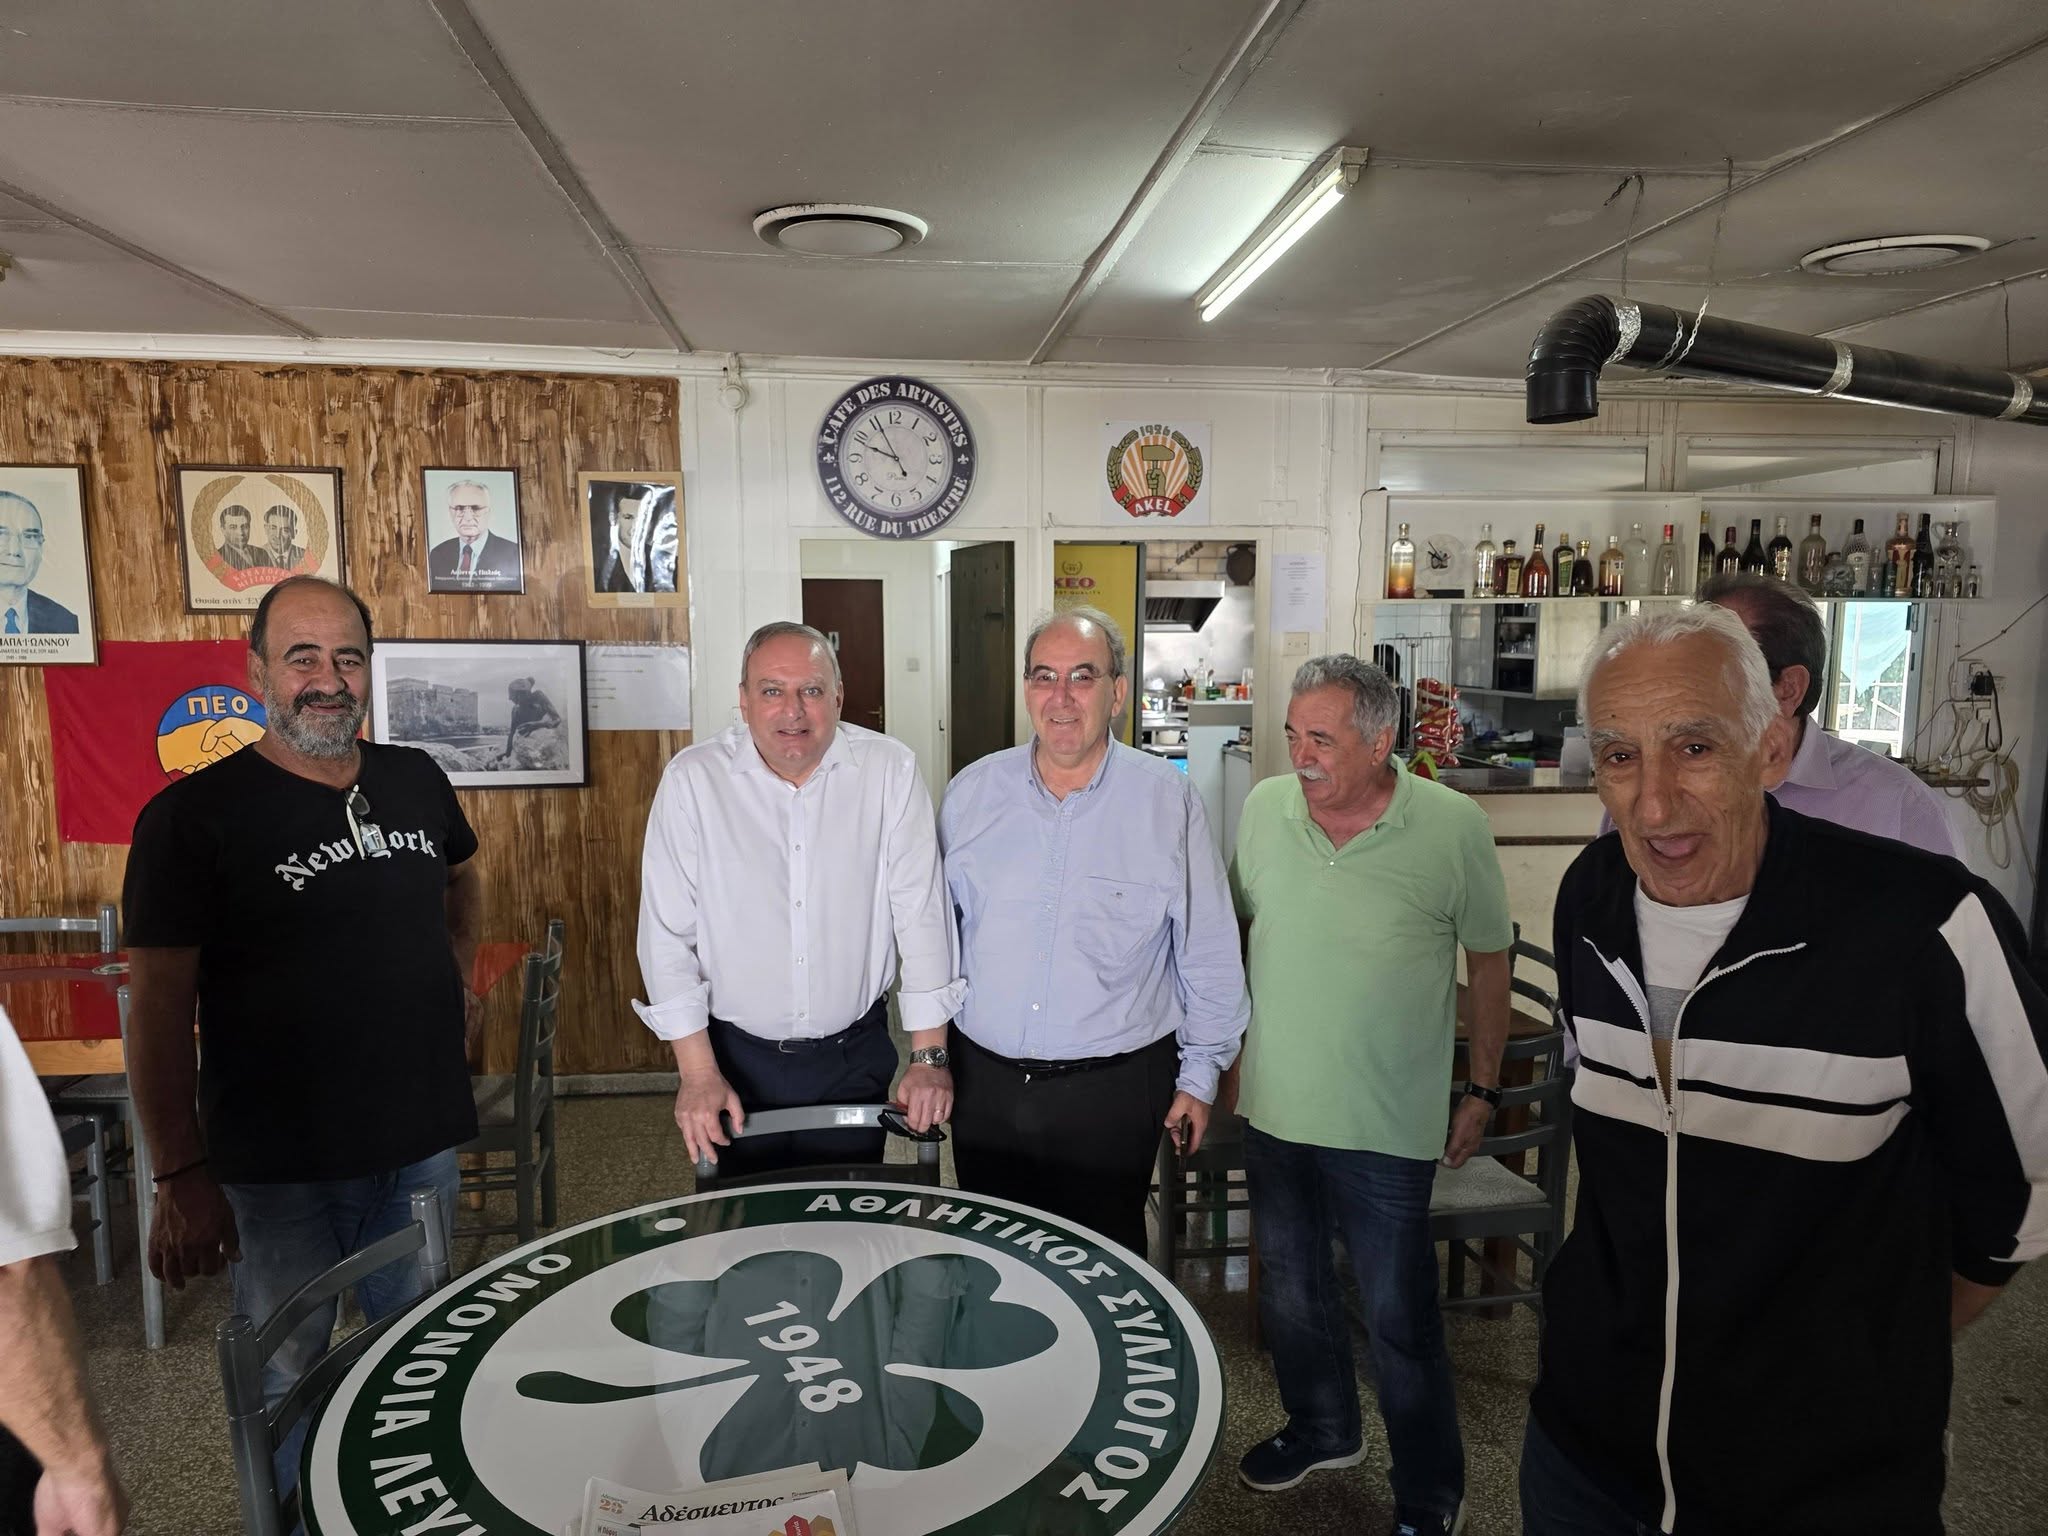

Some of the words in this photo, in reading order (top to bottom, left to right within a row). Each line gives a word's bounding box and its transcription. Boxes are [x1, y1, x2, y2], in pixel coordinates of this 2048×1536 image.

[822, 398, 857, 445] CAFE
[856, 382, 891, 405] DES
[896, 383, 968, 447] ARTISTES
[889, 410, 902, 424] 12
[911, 417, 920, 430] 1
[1140, 424, 1171, 437] 1926
[853, 430, 869, 445] 10
[923, 431, 937, 447] 2
[848, 453, 863, 464] 9
[929, 454, 944, 466] 3
[855, 472, 869, 487] 8
[871, 486, 884, 500] 7
[891, 493, 901, 507] 6
[909, 487, 923, 501] 5
[1135, 499, 1172, 514] AKEL
[880, 520, 903, 536] DU
[1055, 577, 1096, 589] KEO
[187, 695, 249, 716] ΠΕΟ
[275, 837, 355, 891] New
[371, 1253, 572, 1439] ΟΜΟΝΟΙΑ
[743, 1300, 863, 1413] 1948
[805, 1194, 1118, 1285] ΑΘΛΗΤΙΚΟΣ
[1059, 1289, 1177, 1514] ΣΥΛΛΟΓΟΣ
[370, 1452, 488, 1536] ΛΕΥ
[638, 1496, 784, 1522] Αδέσμευτος
